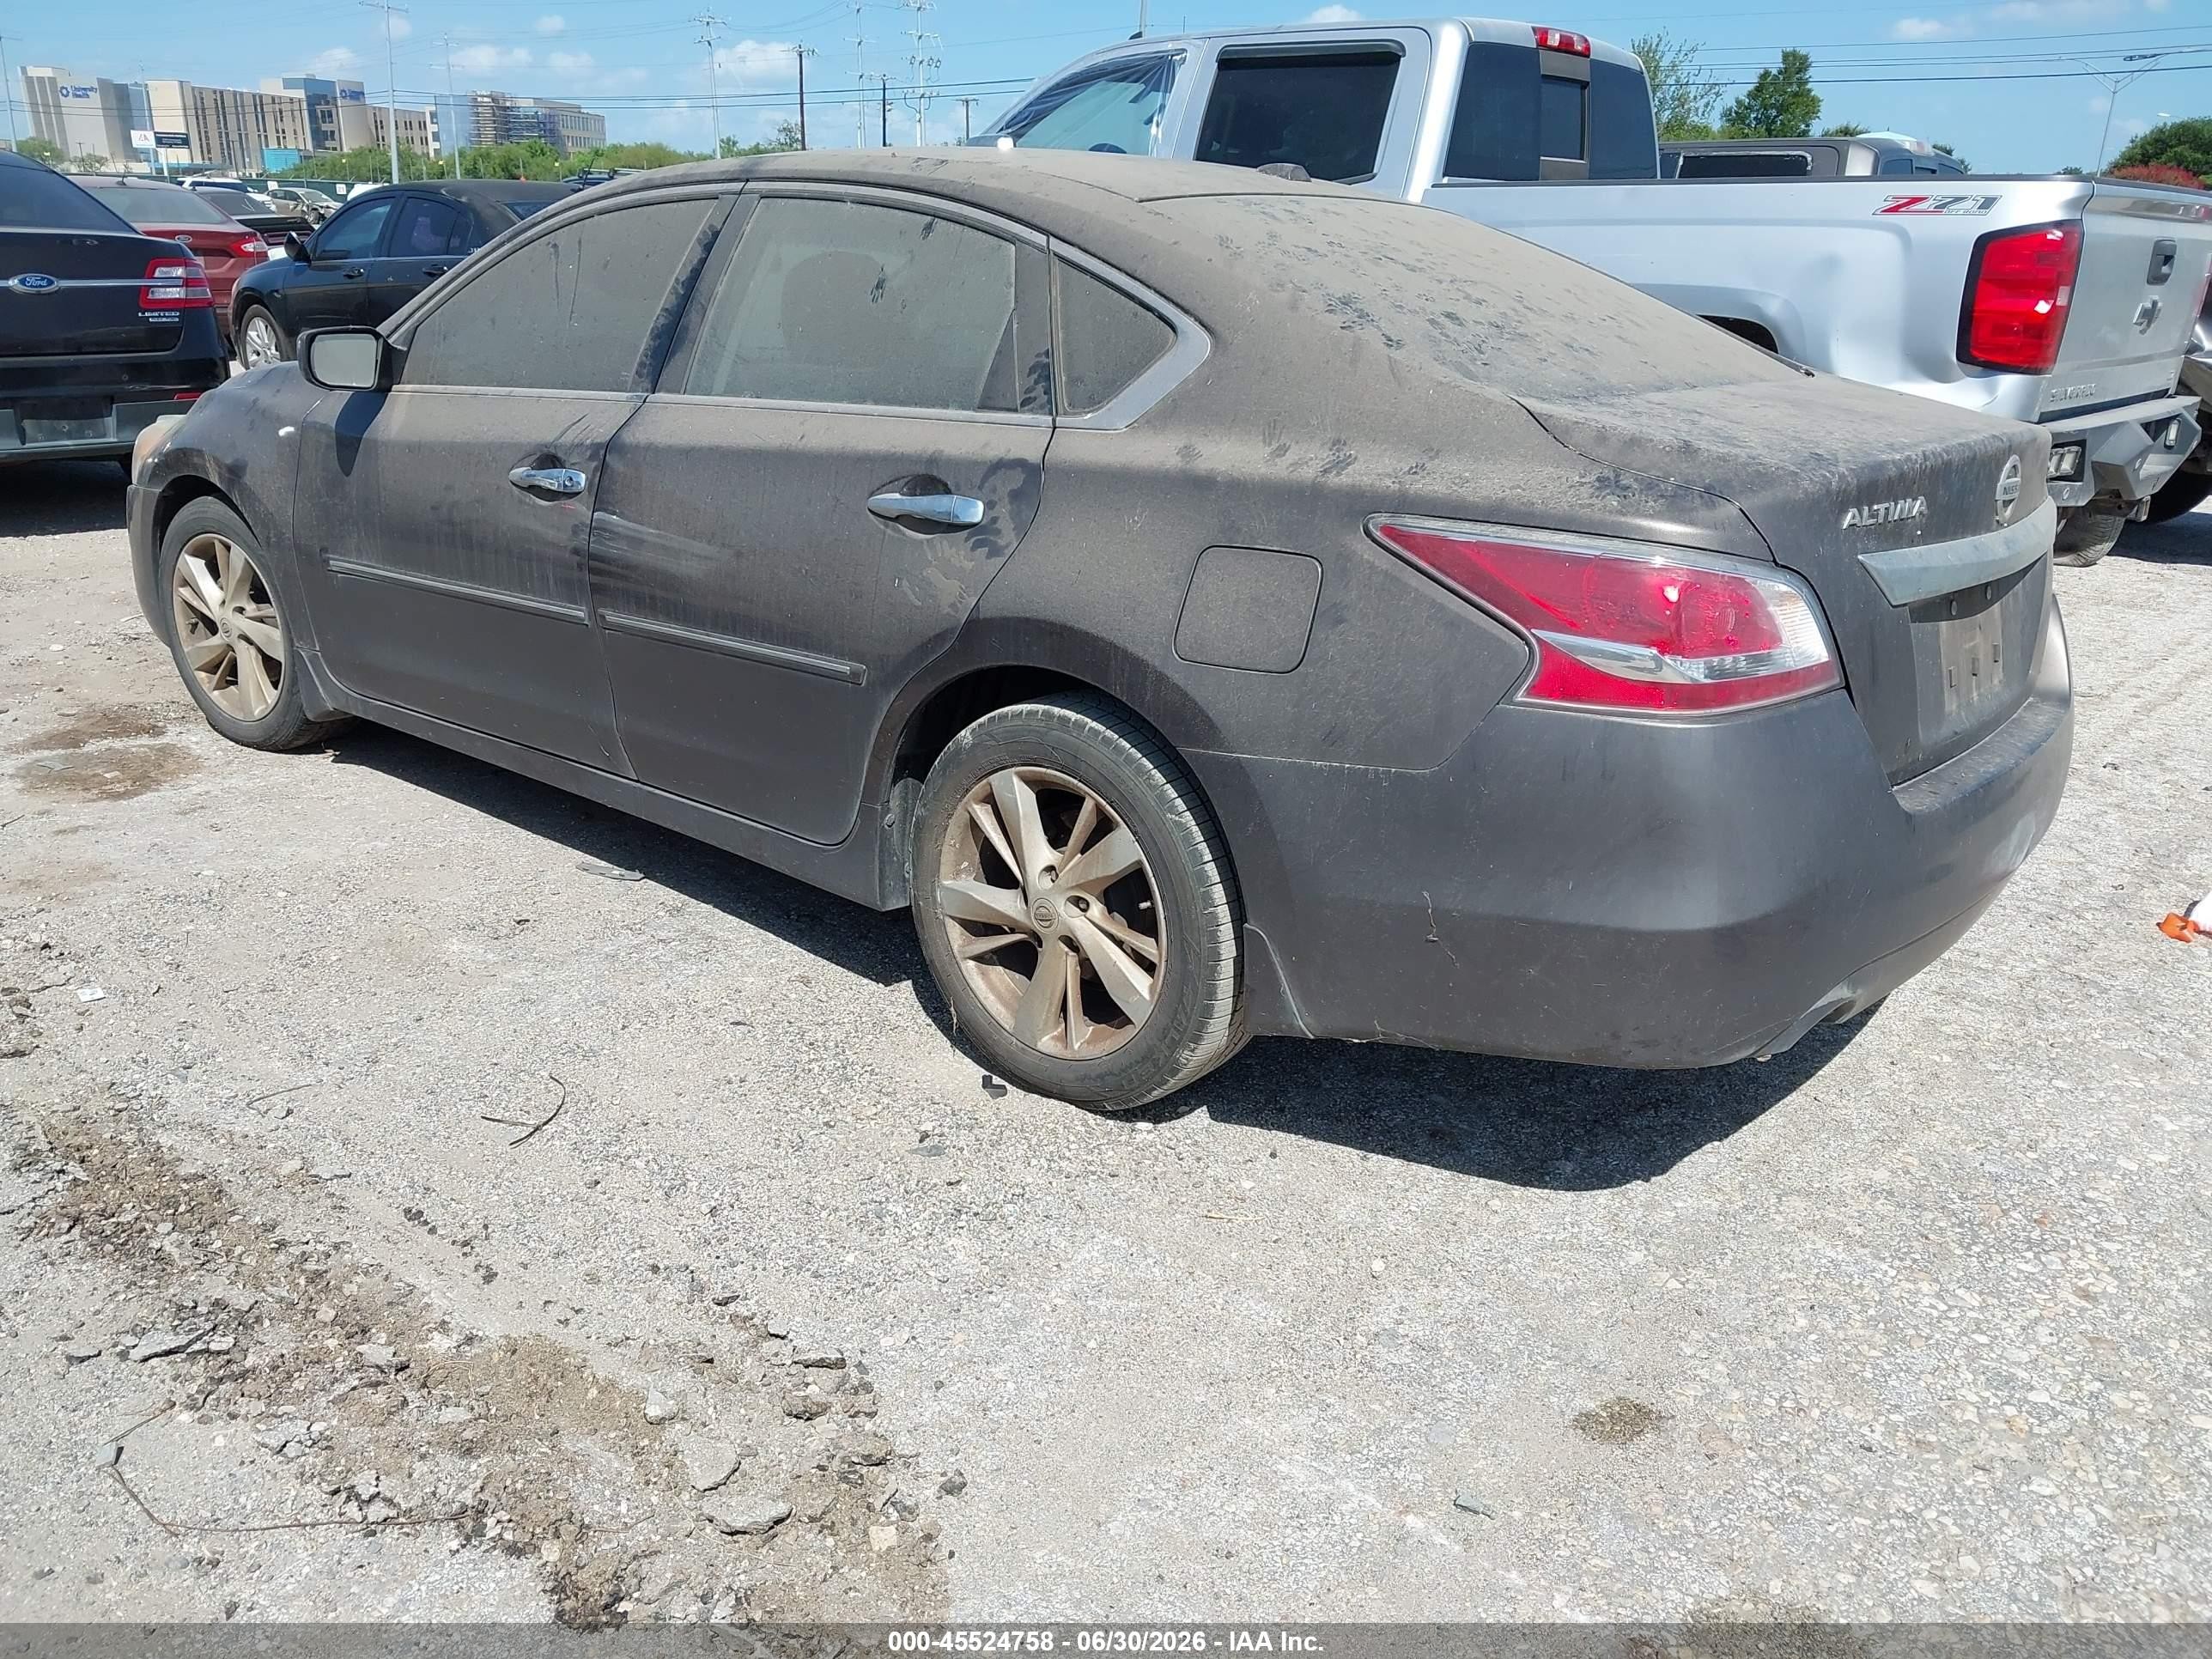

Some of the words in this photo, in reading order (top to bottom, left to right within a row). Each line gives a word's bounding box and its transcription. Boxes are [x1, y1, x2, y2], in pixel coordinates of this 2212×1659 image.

[1875, 195, 2002, 214] Z71
[25, 276, 48, 286] Ford
[1841, 495, 1928, 529] ALTIMA
